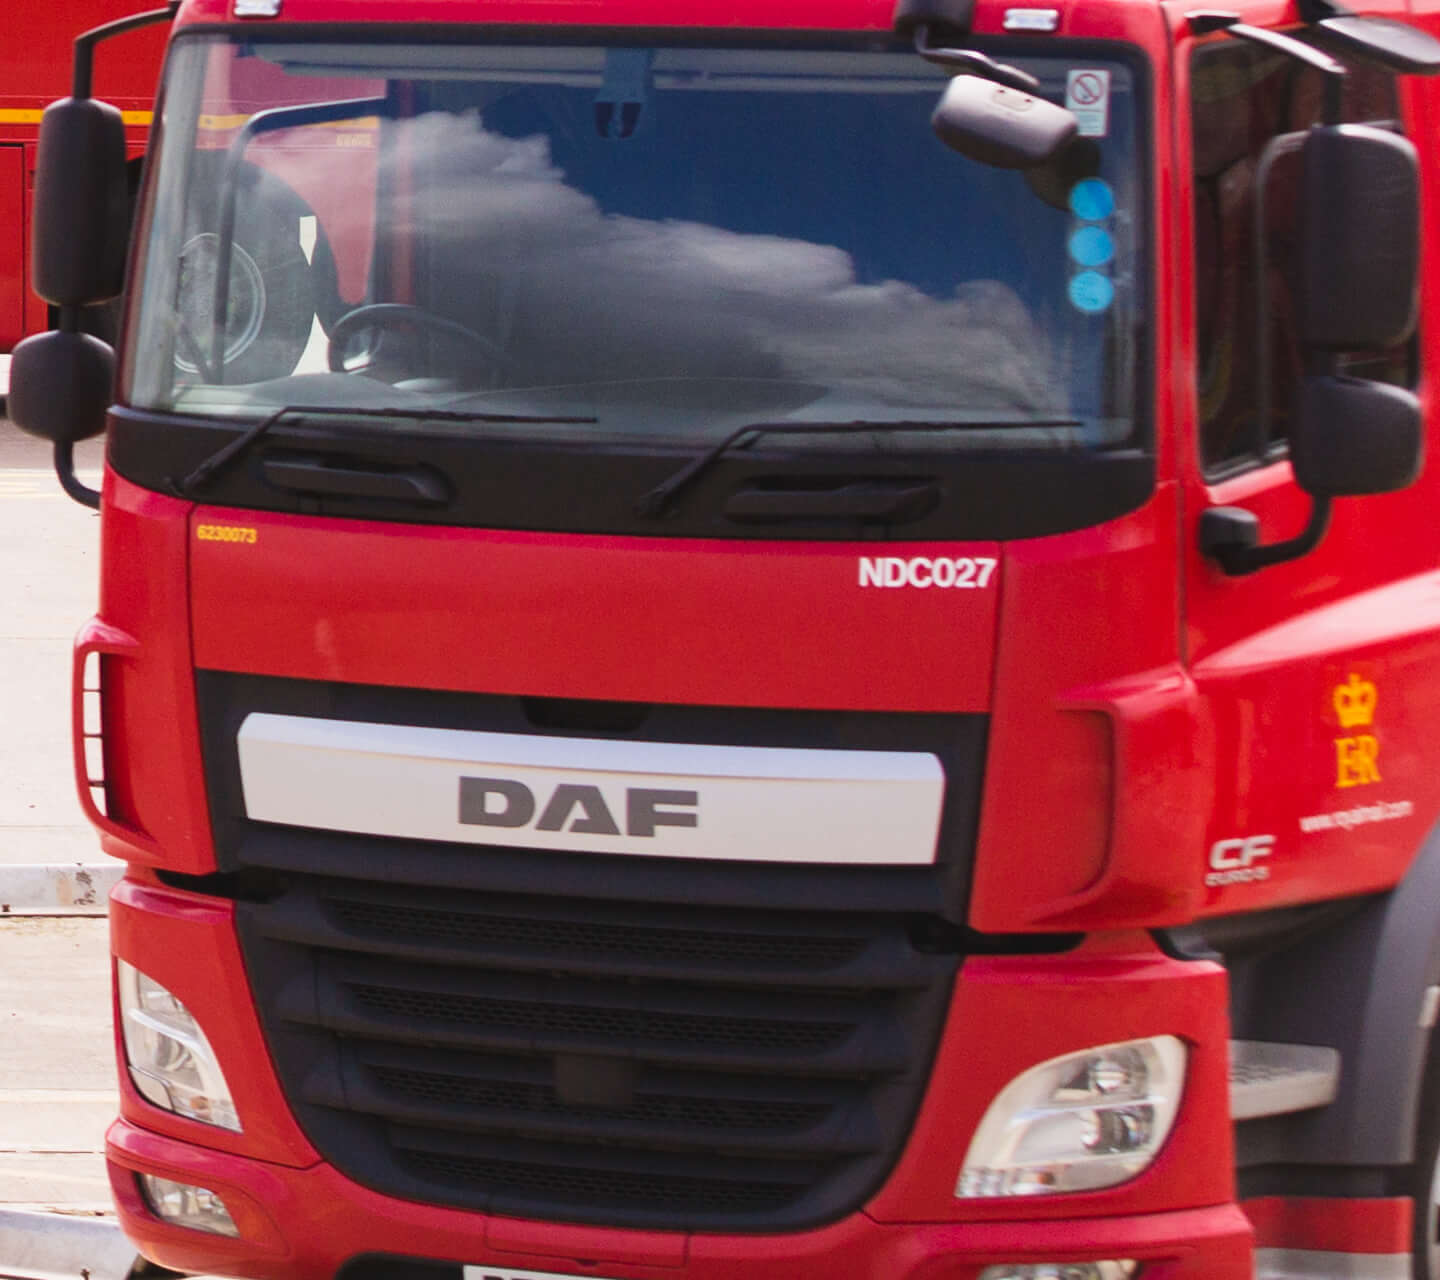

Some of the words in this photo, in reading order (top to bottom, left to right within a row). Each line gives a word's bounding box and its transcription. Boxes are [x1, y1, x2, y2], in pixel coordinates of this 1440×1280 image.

[858, 556, 997, 589] NDC027
[458, 776, 699, 839] DAF
[1210, 834, 1277, 871] CF
